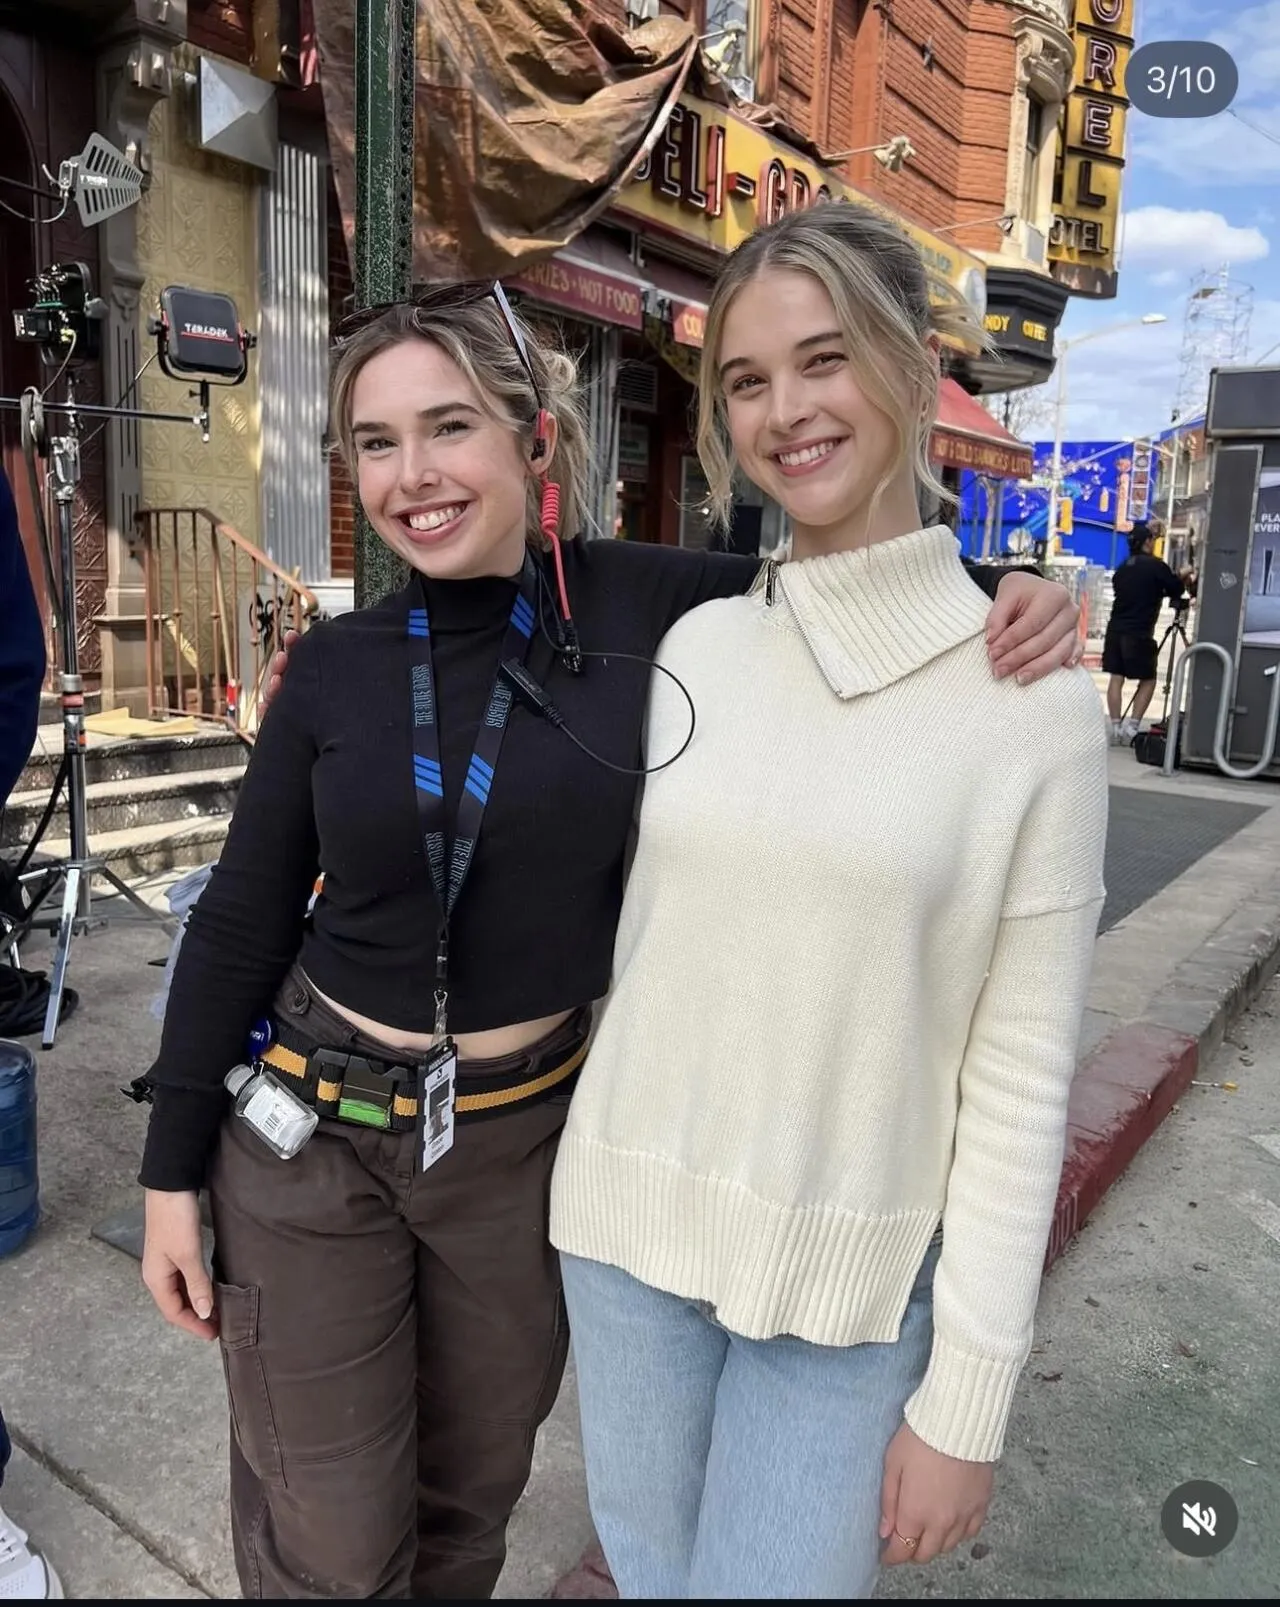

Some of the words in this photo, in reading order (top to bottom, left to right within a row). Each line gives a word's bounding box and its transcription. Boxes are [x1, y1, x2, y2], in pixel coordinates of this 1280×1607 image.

[520, 262, 570, 292] ERIES
[578, 277, 603, 304] HOT
[605, 286, 639, 317] FOOD
[184, 322, 229, 338] TERADEK
[1261, 512, 1280, 523] PLA
[1254, 522, 1280, 533] EVER
[414, 711, 434, 728] THE
